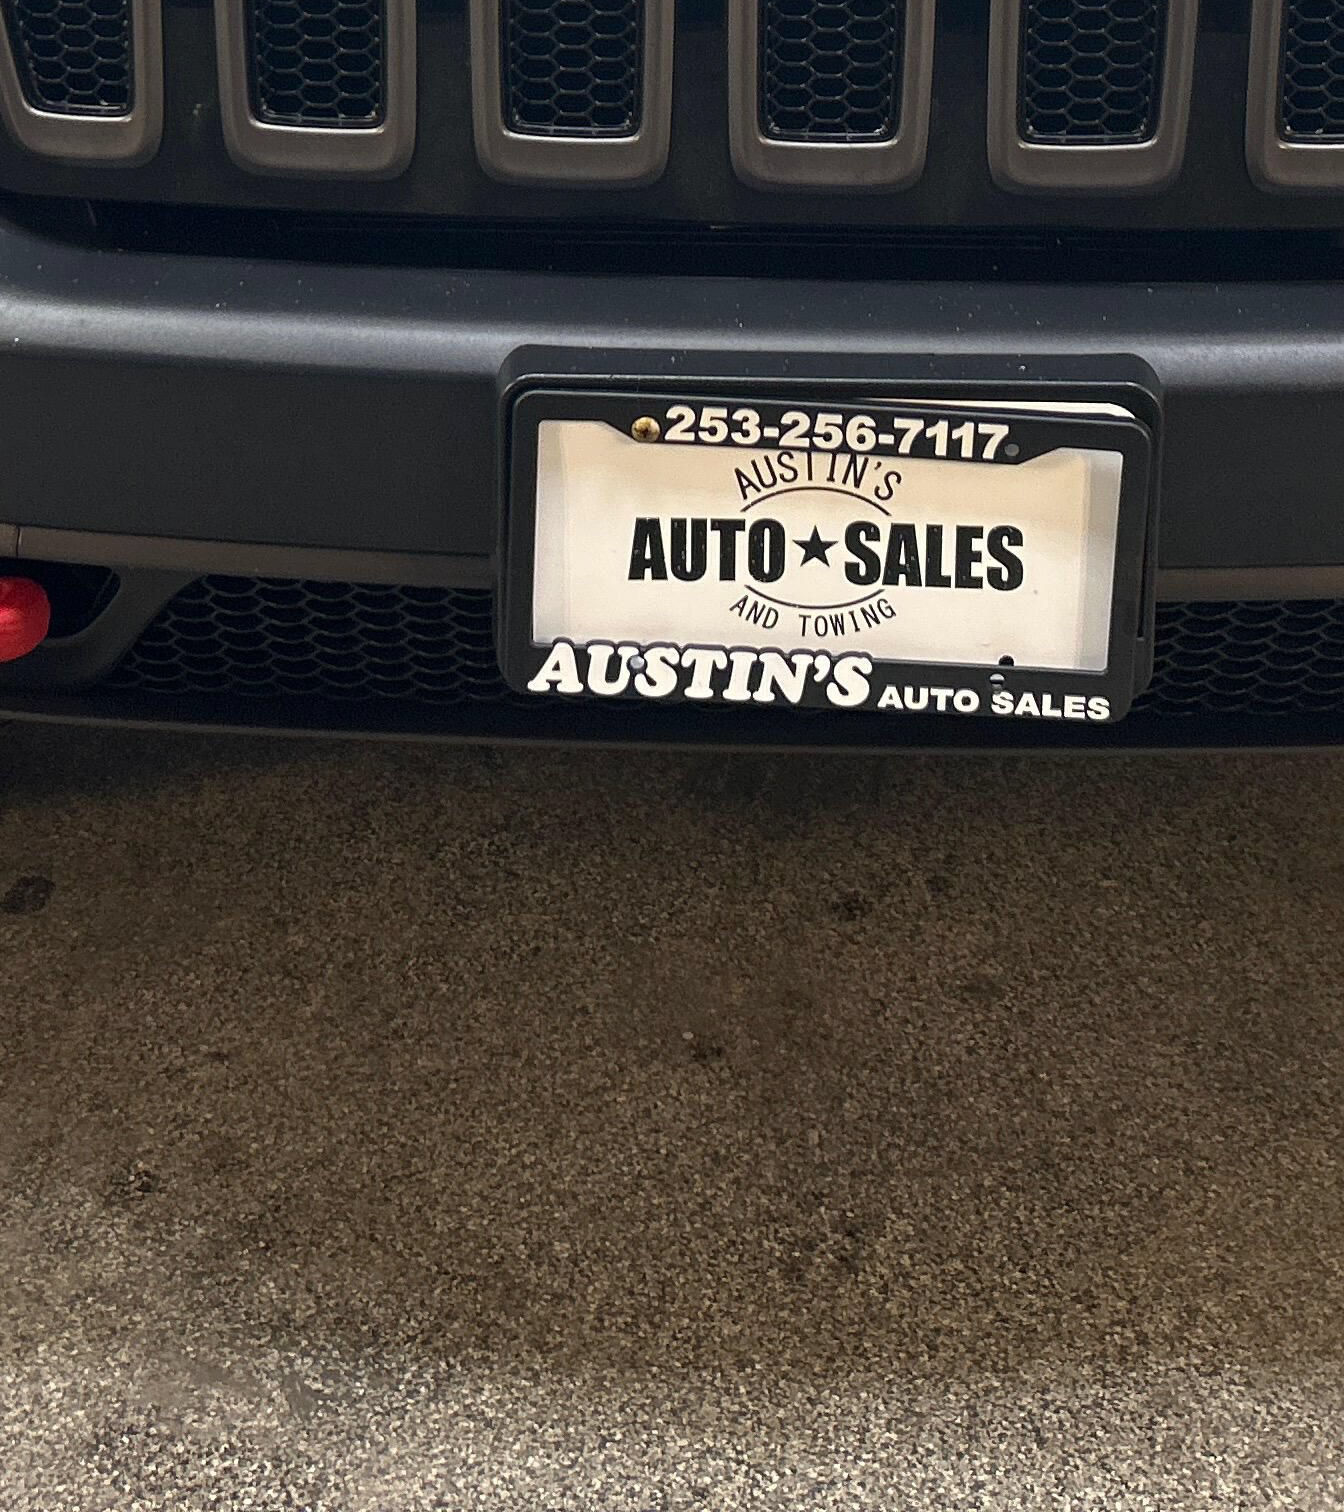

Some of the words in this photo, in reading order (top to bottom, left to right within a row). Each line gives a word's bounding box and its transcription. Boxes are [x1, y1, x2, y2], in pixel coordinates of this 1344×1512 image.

[665, 406, 1009, 460] 253-256-7117
[734, 451, 902, 501] AUSTIN'S
[628, 517, 786, 583] AUTO
[844, 520, 1024, 591] SALES
[729, 595, 779, 629] AND
[799, 598, 897, 637] TOWING
[527, 641, 873, 707] AUSTIN'S
[878, 686, 979, 713] AUTO
[991, 691, 1110, 720] SALES
